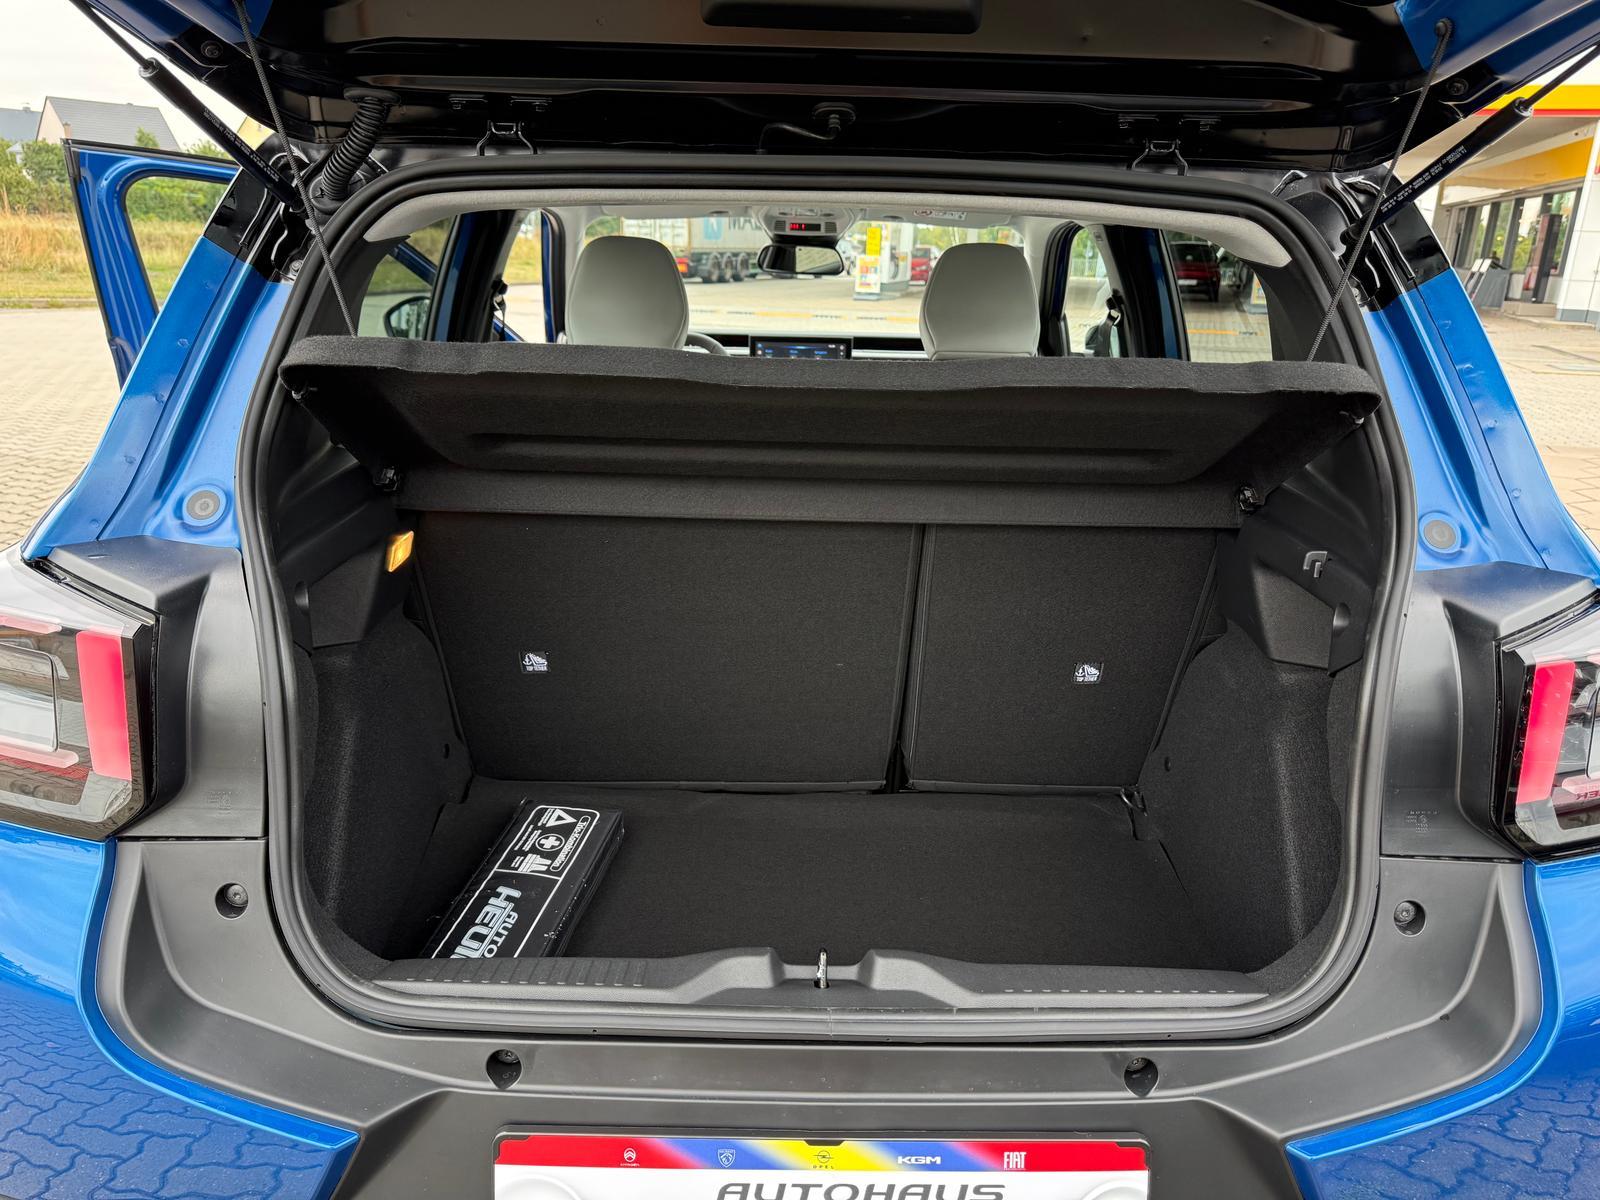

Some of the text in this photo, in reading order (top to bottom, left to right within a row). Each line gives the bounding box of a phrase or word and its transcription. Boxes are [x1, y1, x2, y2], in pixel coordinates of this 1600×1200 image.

[897, 1155, 942, 1165] KGM
[1003, 1151, 1027, 1168] FIAT
[717, 1183, 1006, 1200] AUTOHAUS
